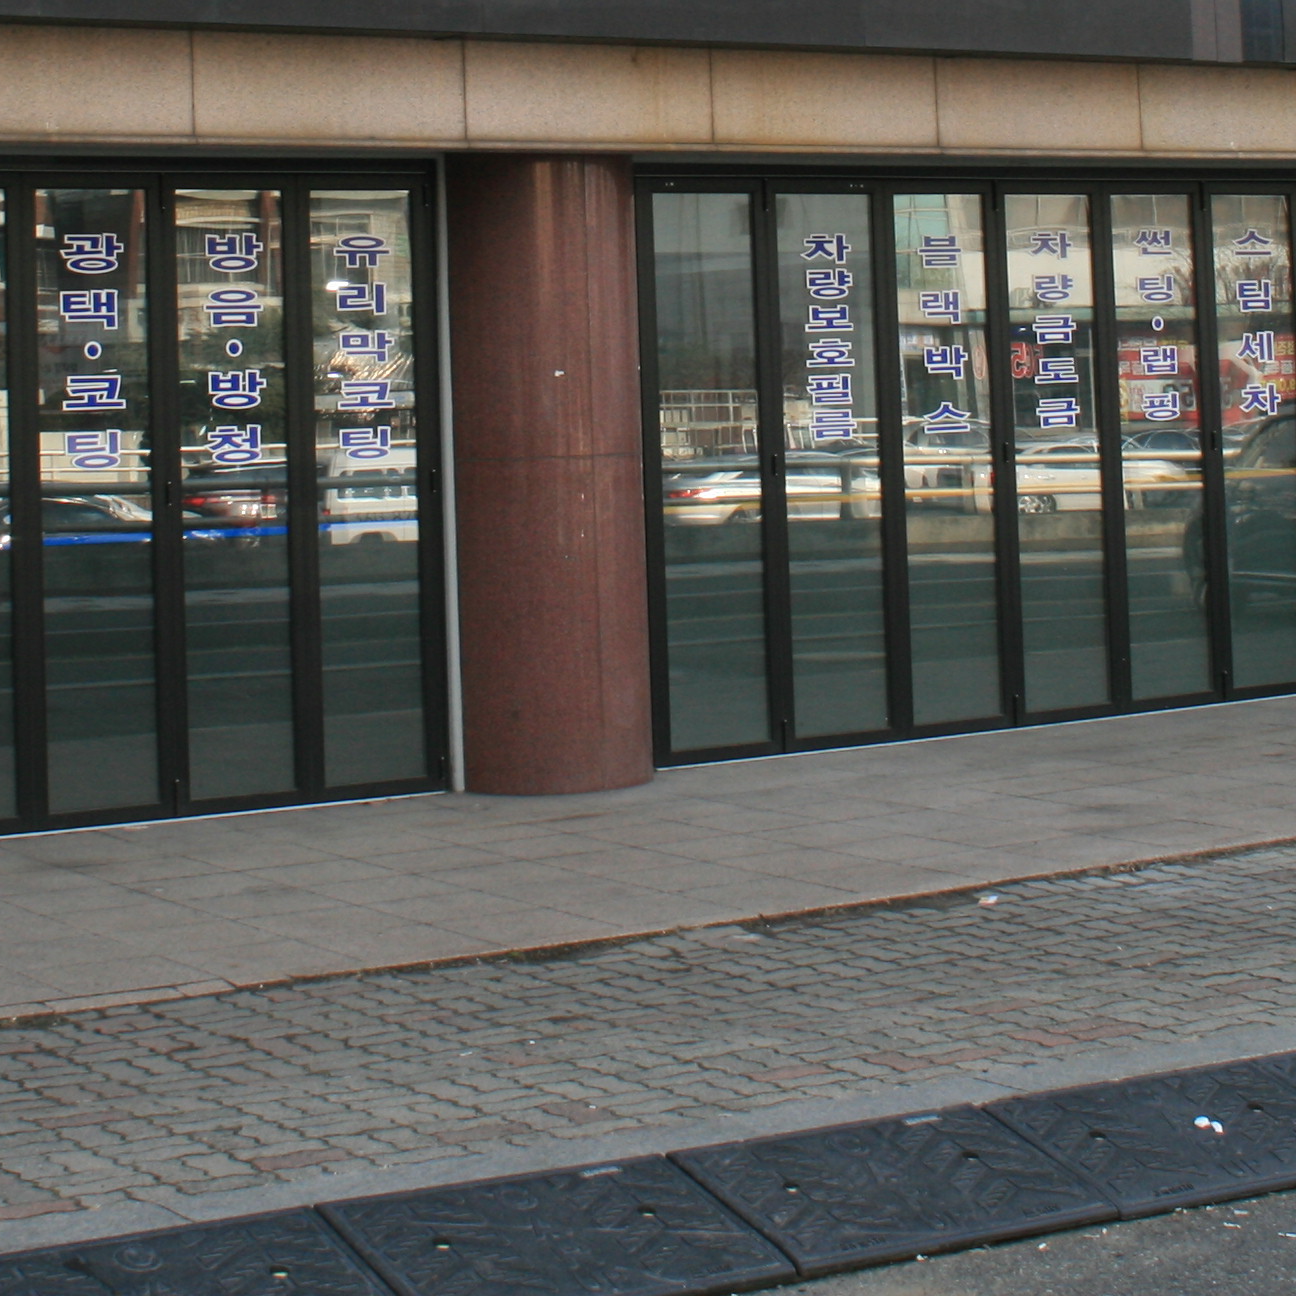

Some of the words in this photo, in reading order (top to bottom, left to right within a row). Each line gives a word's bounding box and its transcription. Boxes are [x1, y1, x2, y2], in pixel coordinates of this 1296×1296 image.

[333, 234, 396, 460] 유리막코팅
[800, 233, 858, 441] 차량보호필름
[917, 234, 972, 435] 블랙박스
[1234, 229, 1282, 416] 스팀세차
